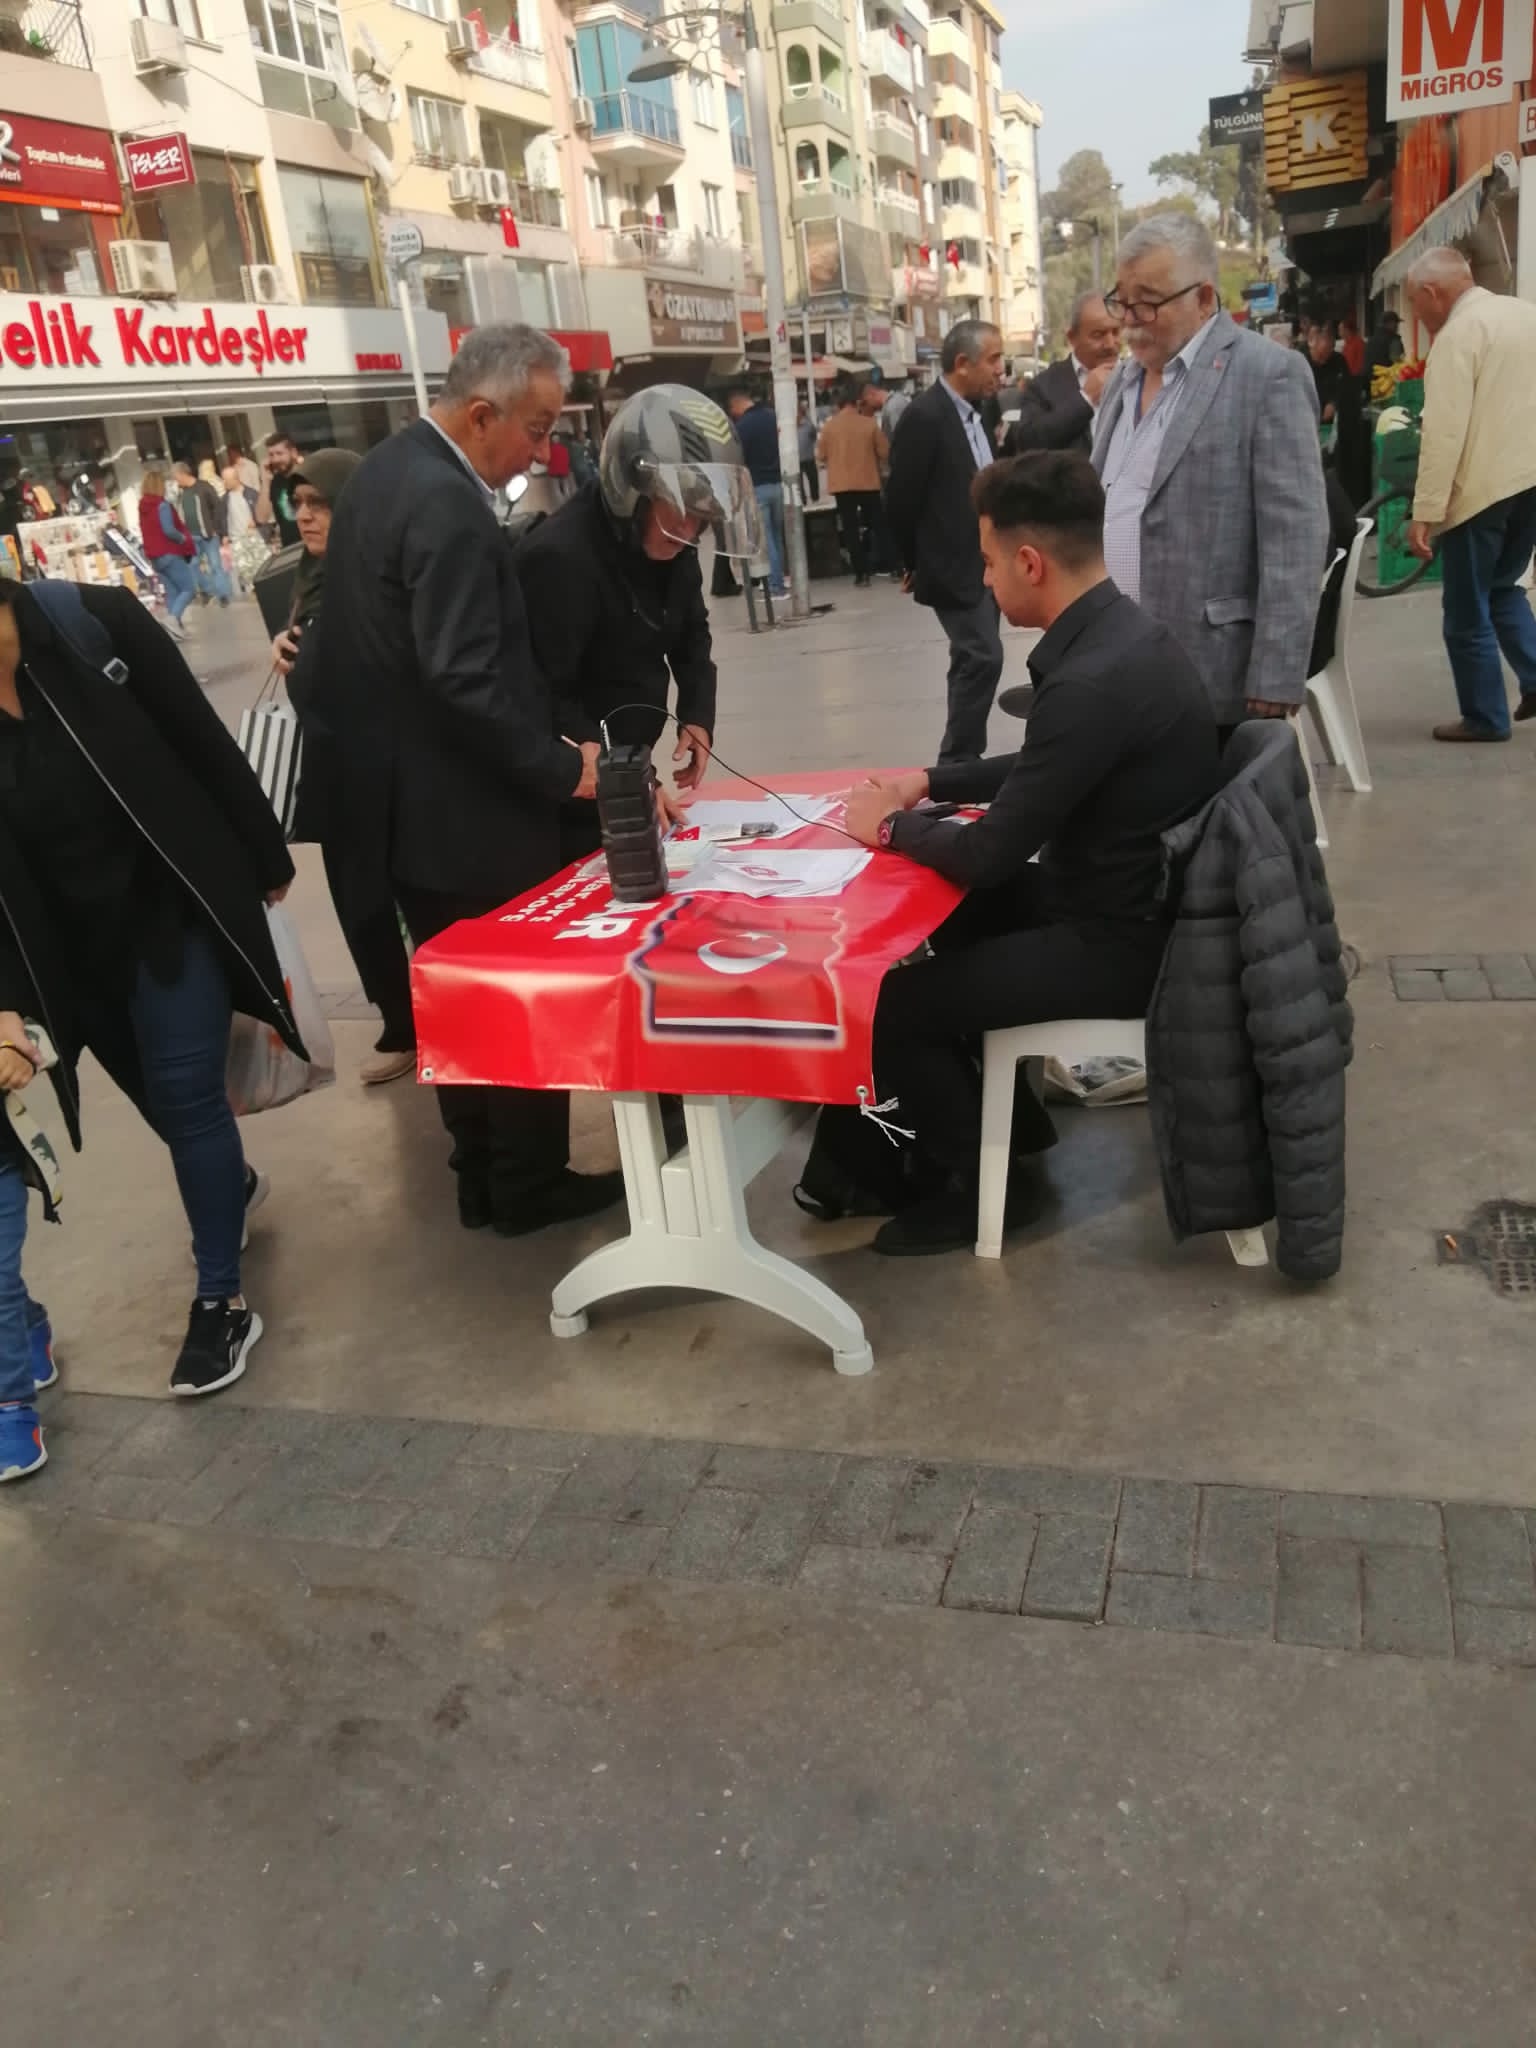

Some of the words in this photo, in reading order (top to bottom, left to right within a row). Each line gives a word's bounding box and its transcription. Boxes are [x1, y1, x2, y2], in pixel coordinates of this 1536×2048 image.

[1401, 0, 1504, 76] M
[1301, 111, 1341, 154] K
[0, 301, 101, 367] elik
[114, 307, 307, 375] Kardeşler
